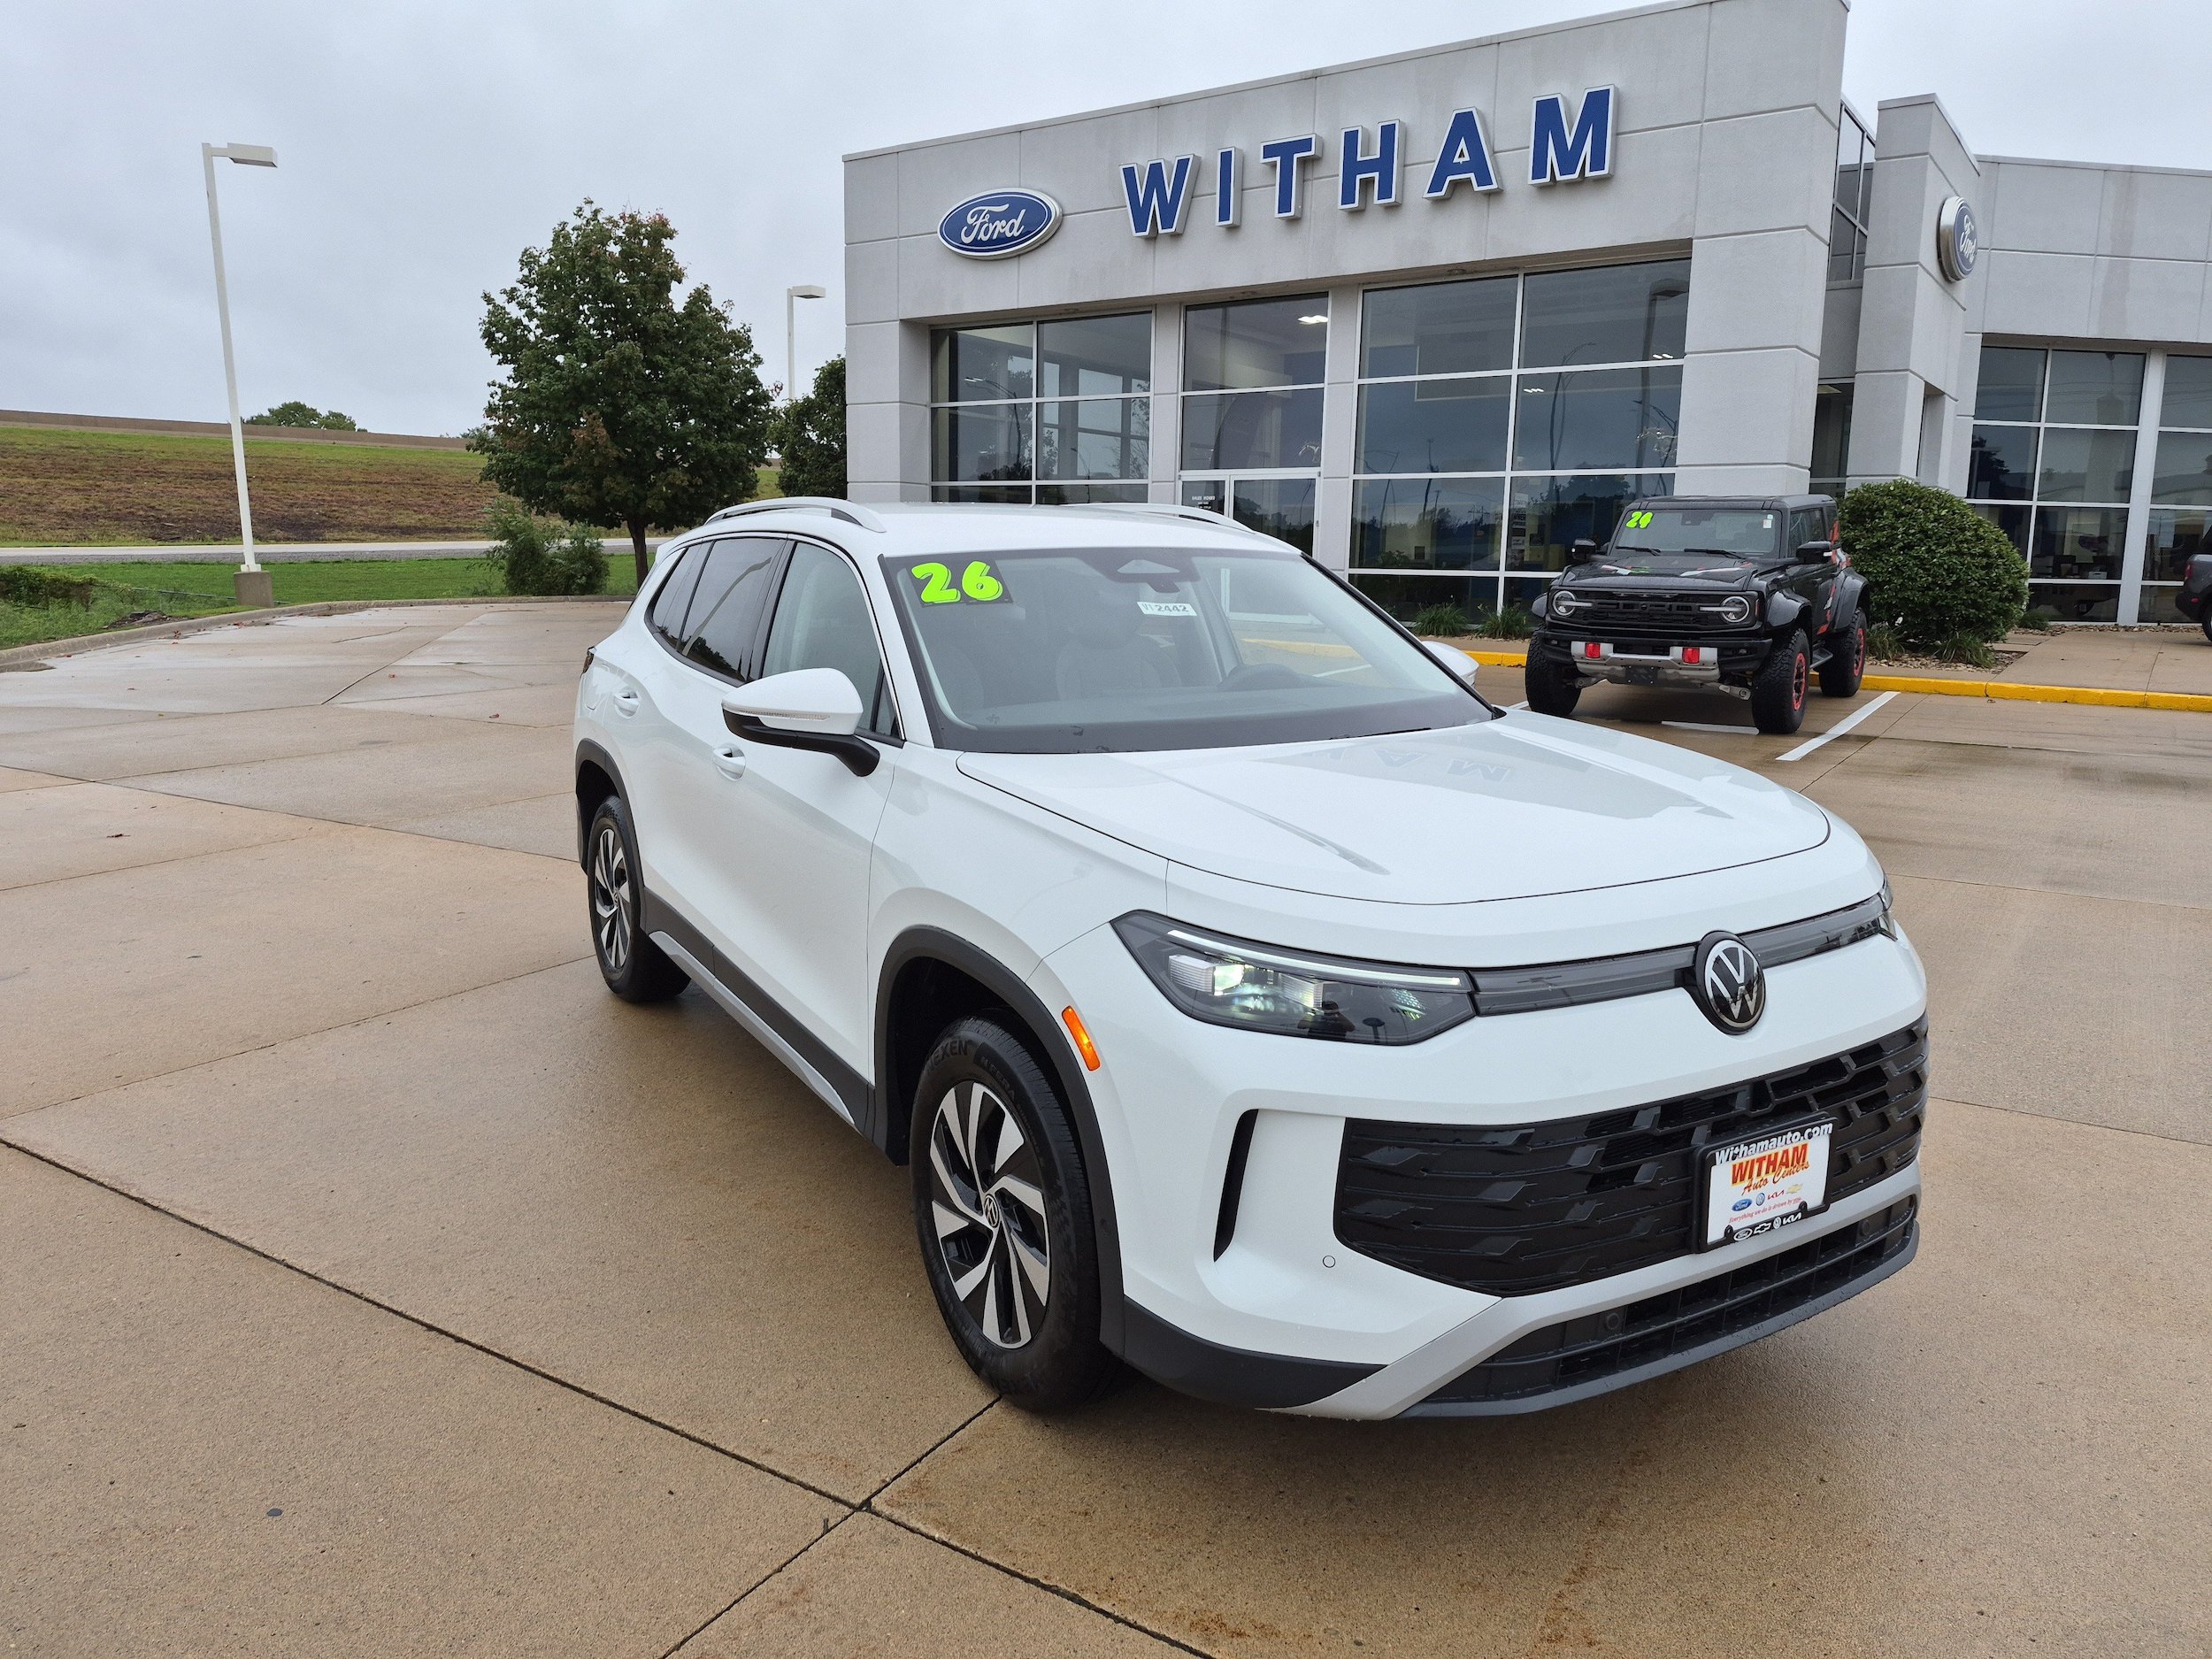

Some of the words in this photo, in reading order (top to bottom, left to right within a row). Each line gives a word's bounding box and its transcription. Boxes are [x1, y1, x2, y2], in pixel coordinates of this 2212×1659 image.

[1118, 84, 1619, 239] WITHAM
[961, 204, 1026, 244] Ford
[1960, 214, 1978, 264] Ford
[911, 560, 1003, 604] 26
[1732, 1143, 1809, 1186] WITHAM
[1741, 1177, 1769, 1196] Auto
[1772, 1161, 1810, 1184] Centers
